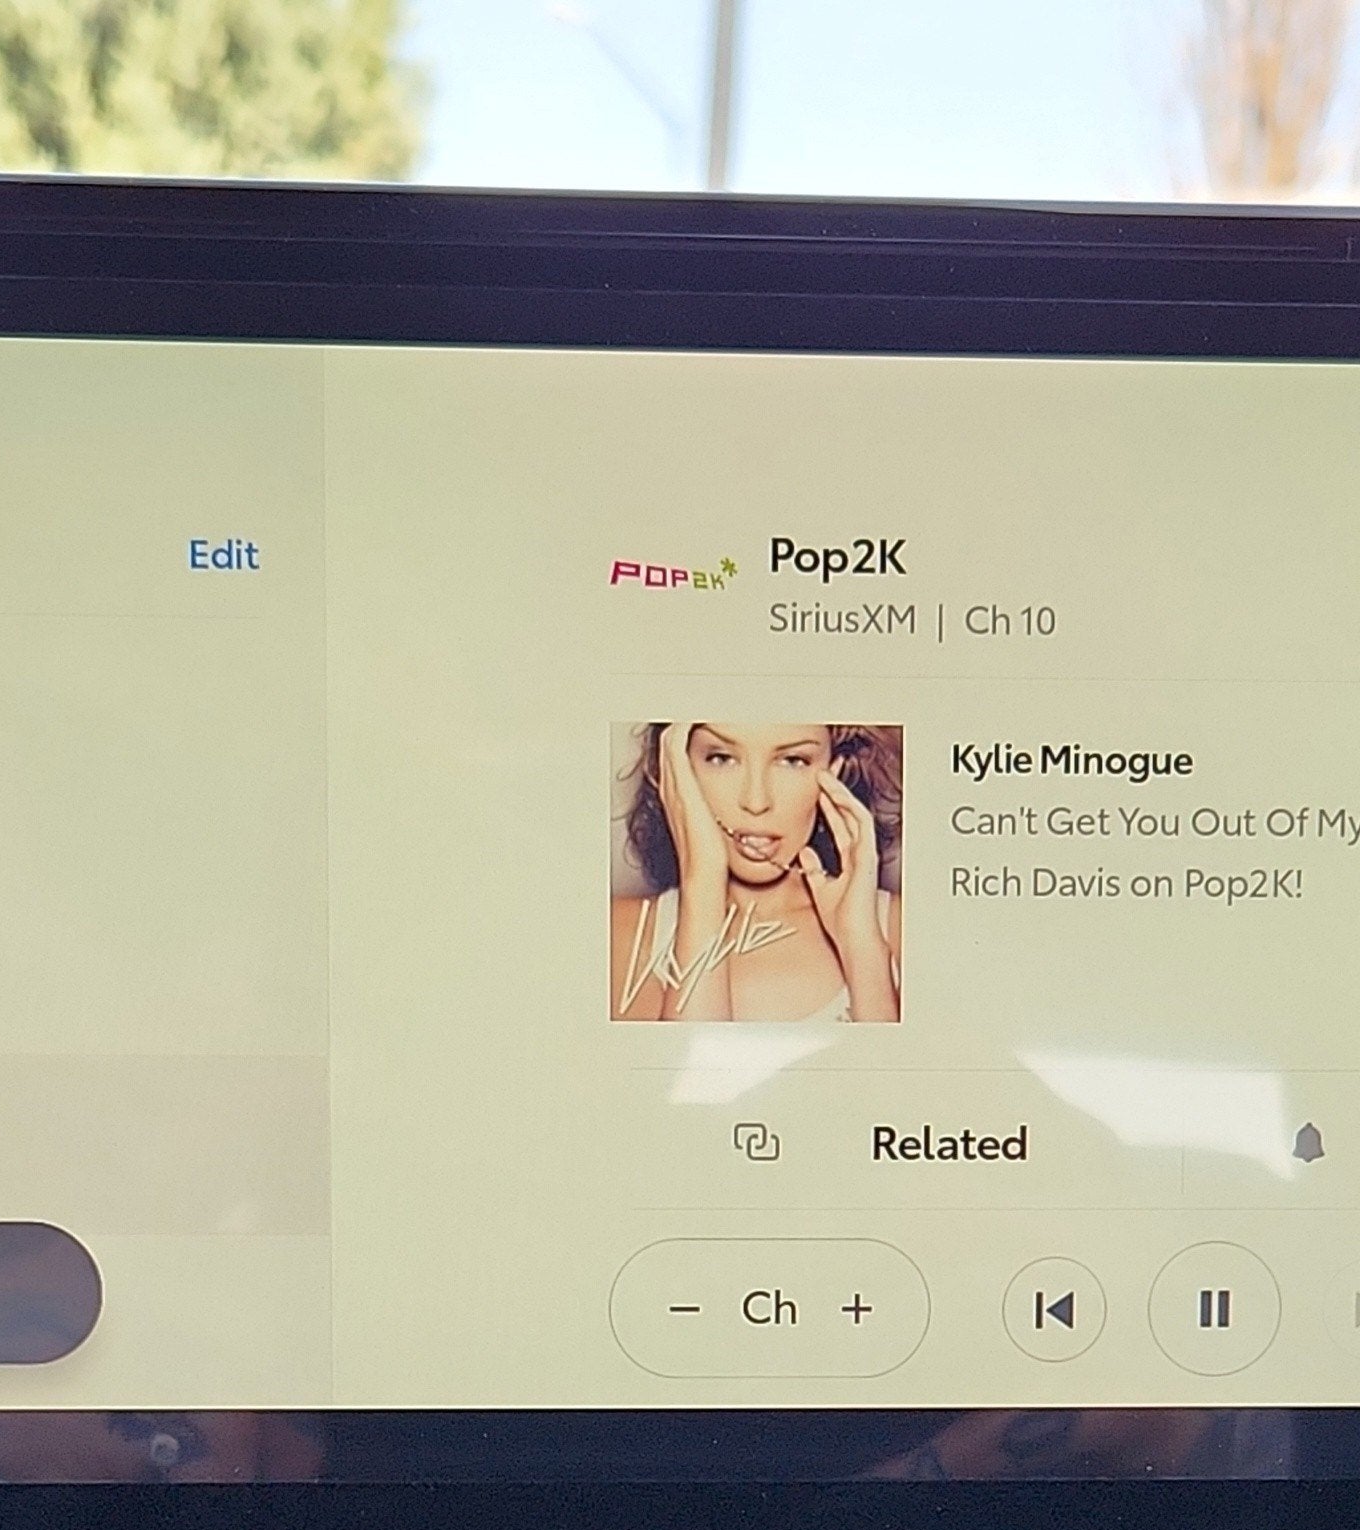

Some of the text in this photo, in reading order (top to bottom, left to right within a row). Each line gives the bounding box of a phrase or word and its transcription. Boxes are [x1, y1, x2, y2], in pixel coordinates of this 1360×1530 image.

[189, 538, 261, 571] Edit
[770, 537, 907, 584] Pop2K
[768, 601, 1057, 637] SiriusXM Ch 10
[952, 742, 1194, 785] Kylie Minogue
[950, 804, 1039, 837] Can't
[1046, 805, 1112, 837] Get
[1118, 806, 1181, 837] You
[1190, 806, 1258, 838] Out
[1266, 805, 1311, 838] Of
[951, 864, 1303, 907] Rich Davis on Pop2K!
[872, 1125, 1028, 1162] Related
[742, 1288, 798, 1326] Ch
